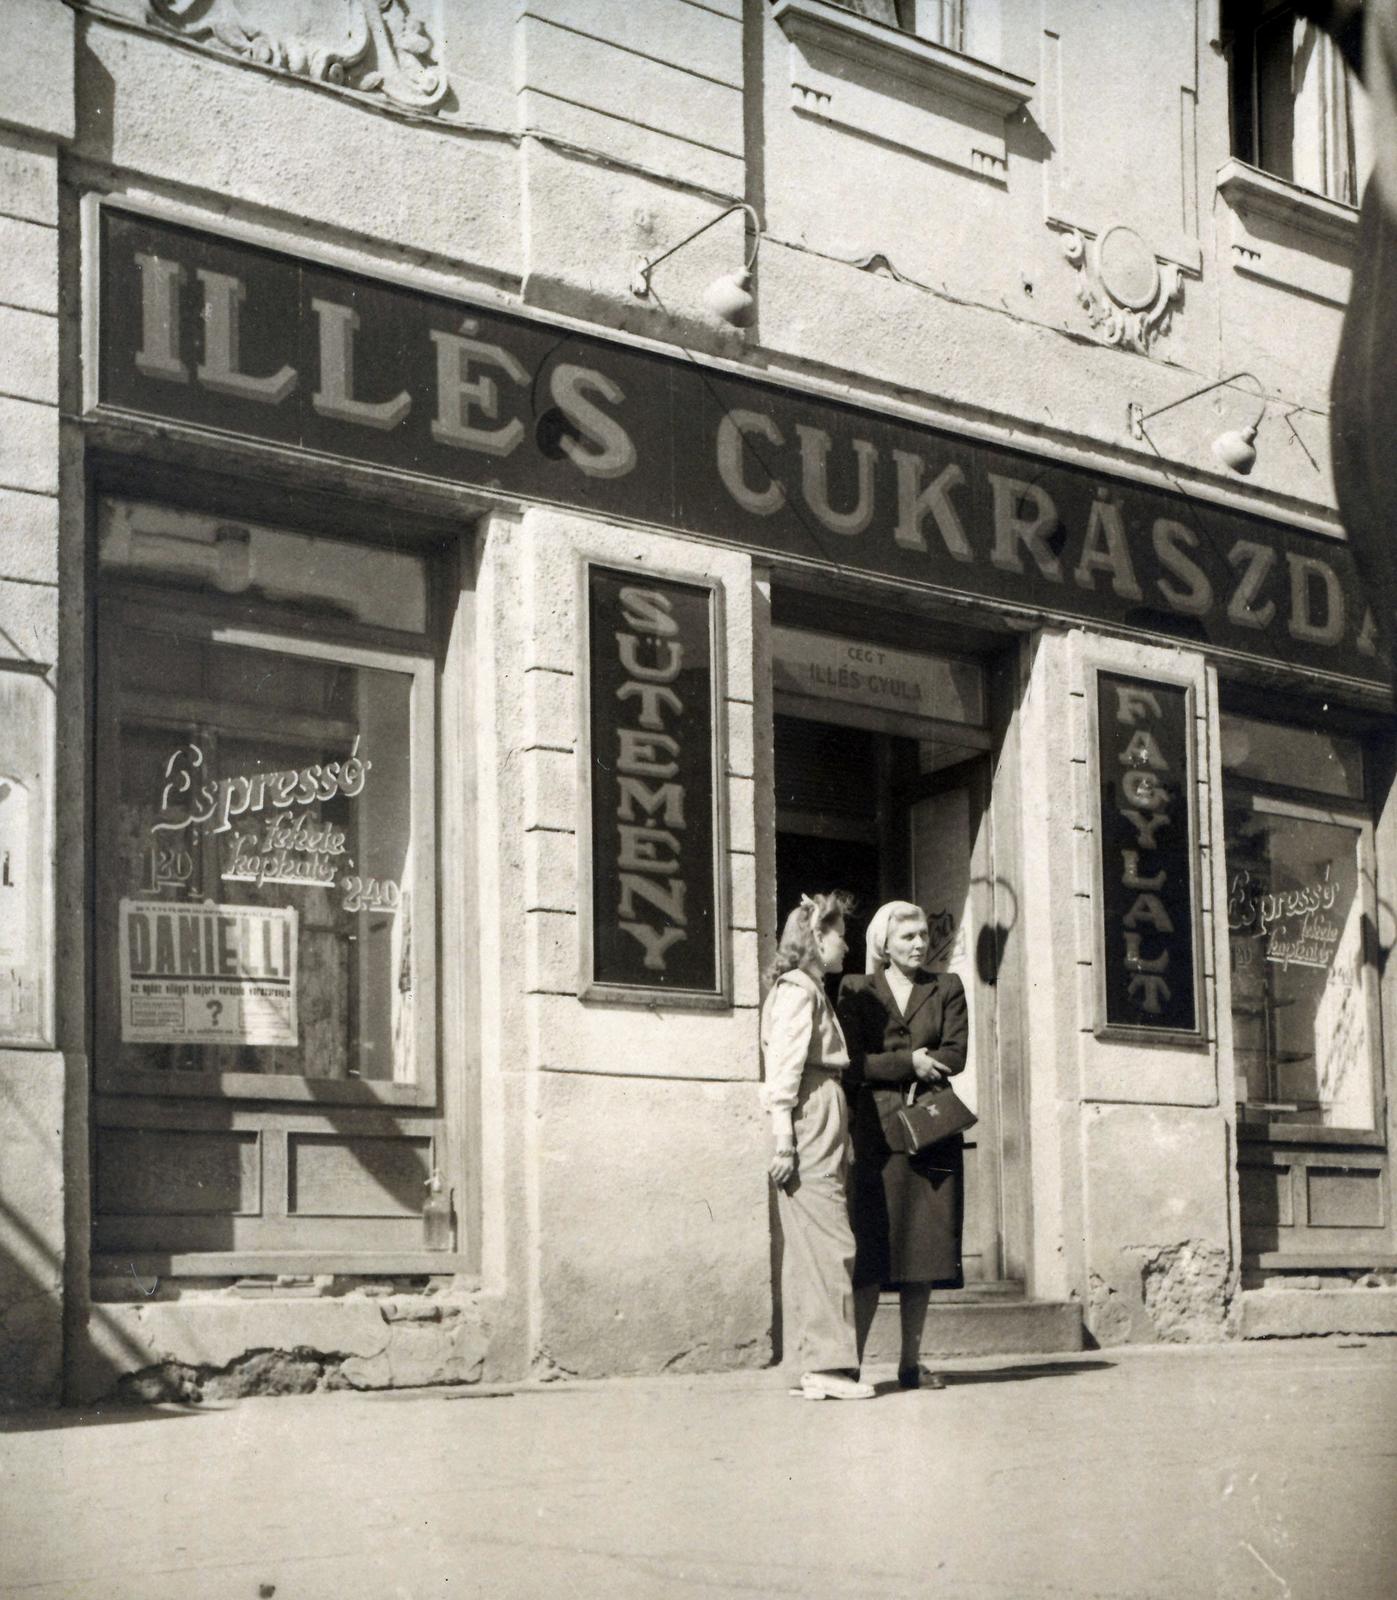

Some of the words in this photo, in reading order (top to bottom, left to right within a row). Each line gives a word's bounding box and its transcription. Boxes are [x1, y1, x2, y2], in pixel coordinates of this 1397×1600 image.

[133, 252, 638, 479] ILLÉS
[716, 408, 1379, 658] CUKRÁSZD
[614, 585, 688, 971] SÜTEMÉNY
[809, 662, 861, 690] ILLÉS
[151, 735, 372, 833] Espressó
[1115, 686, 1175, 1014] FAGYLALT
[127, 913, 291, 977] DANIELLI
